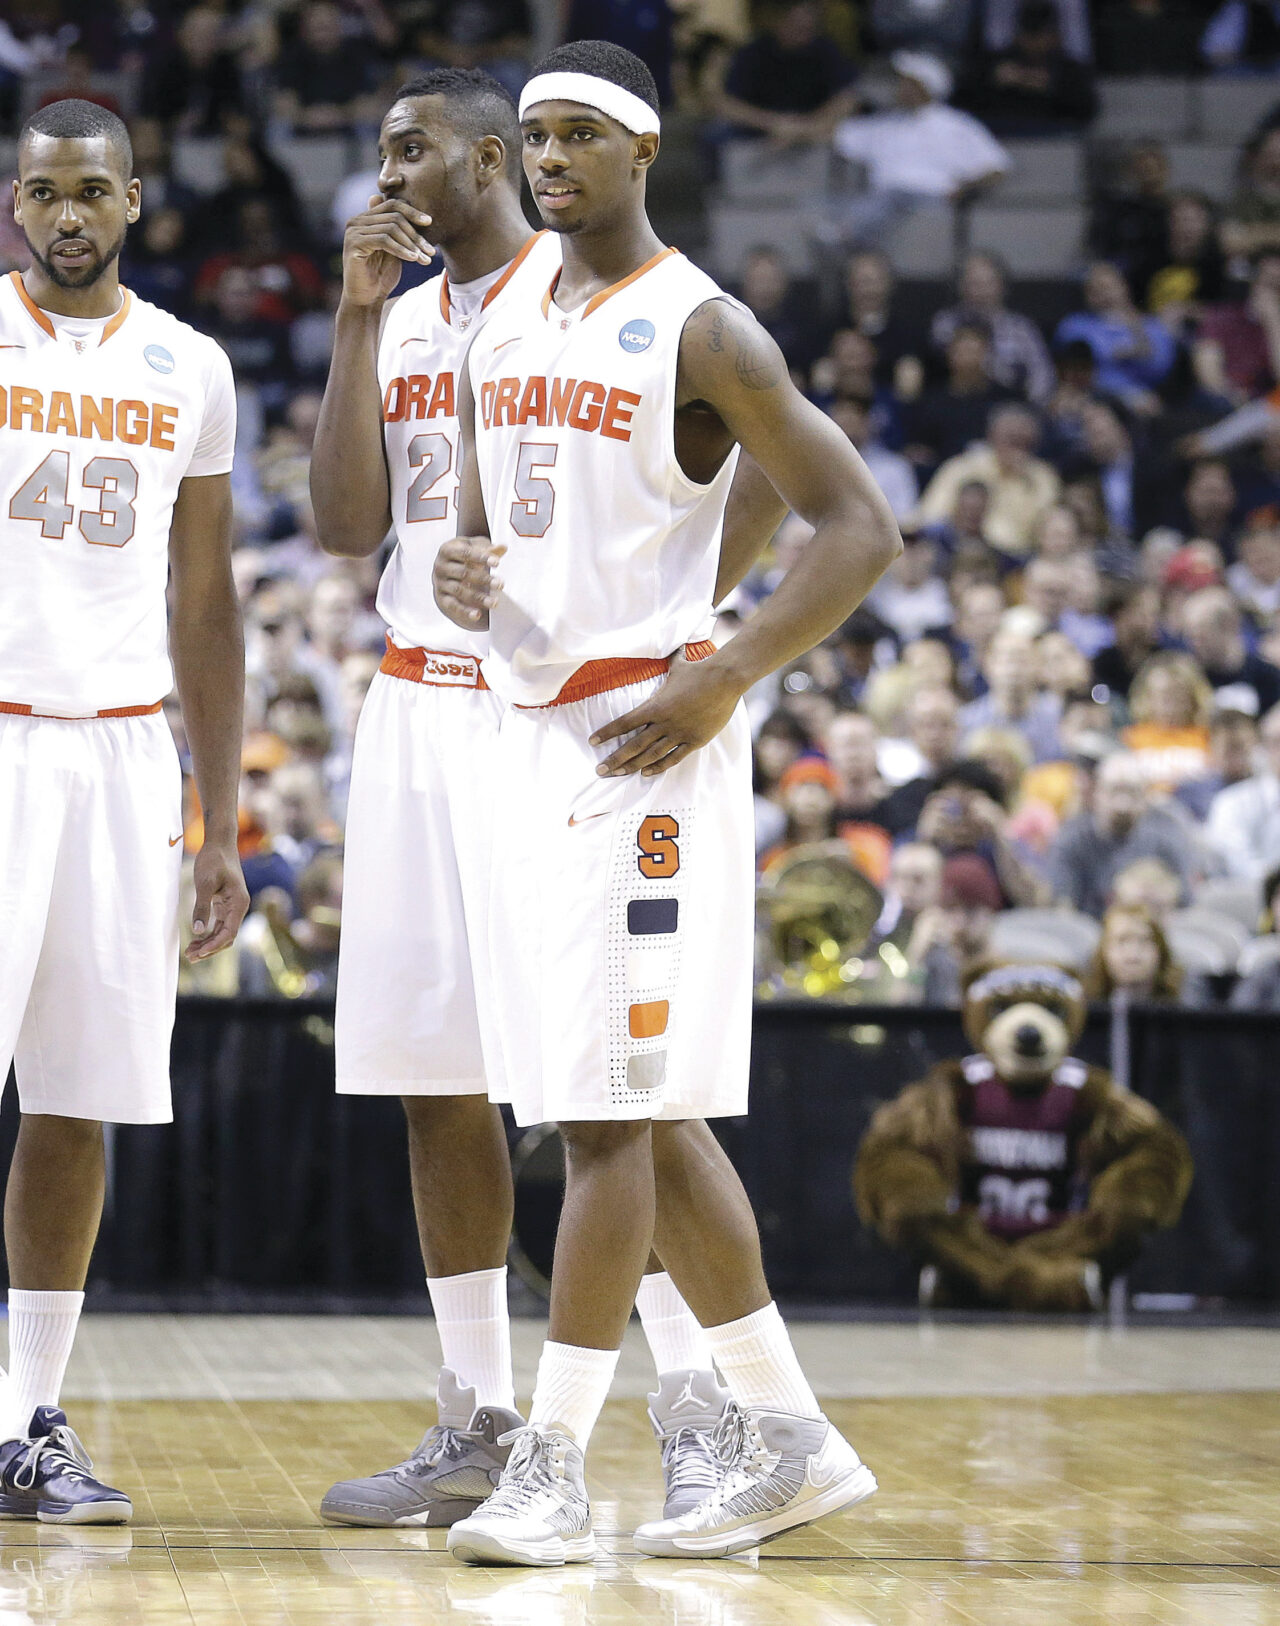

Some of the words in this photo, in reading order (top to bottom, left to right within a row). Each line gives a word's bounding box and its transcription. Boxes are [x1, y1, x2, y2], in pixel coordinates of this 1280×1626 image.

[621, 331, 651, 346] NCAA
[383, 371, 460, 423] ORA
[480, 375, 642, 443] ORANGE
[8, 448, 139, 548] 43
[406, 431, 464, 524] 2
[509, 441, 559, 538] 5
[636, 814, 680, 879] S
